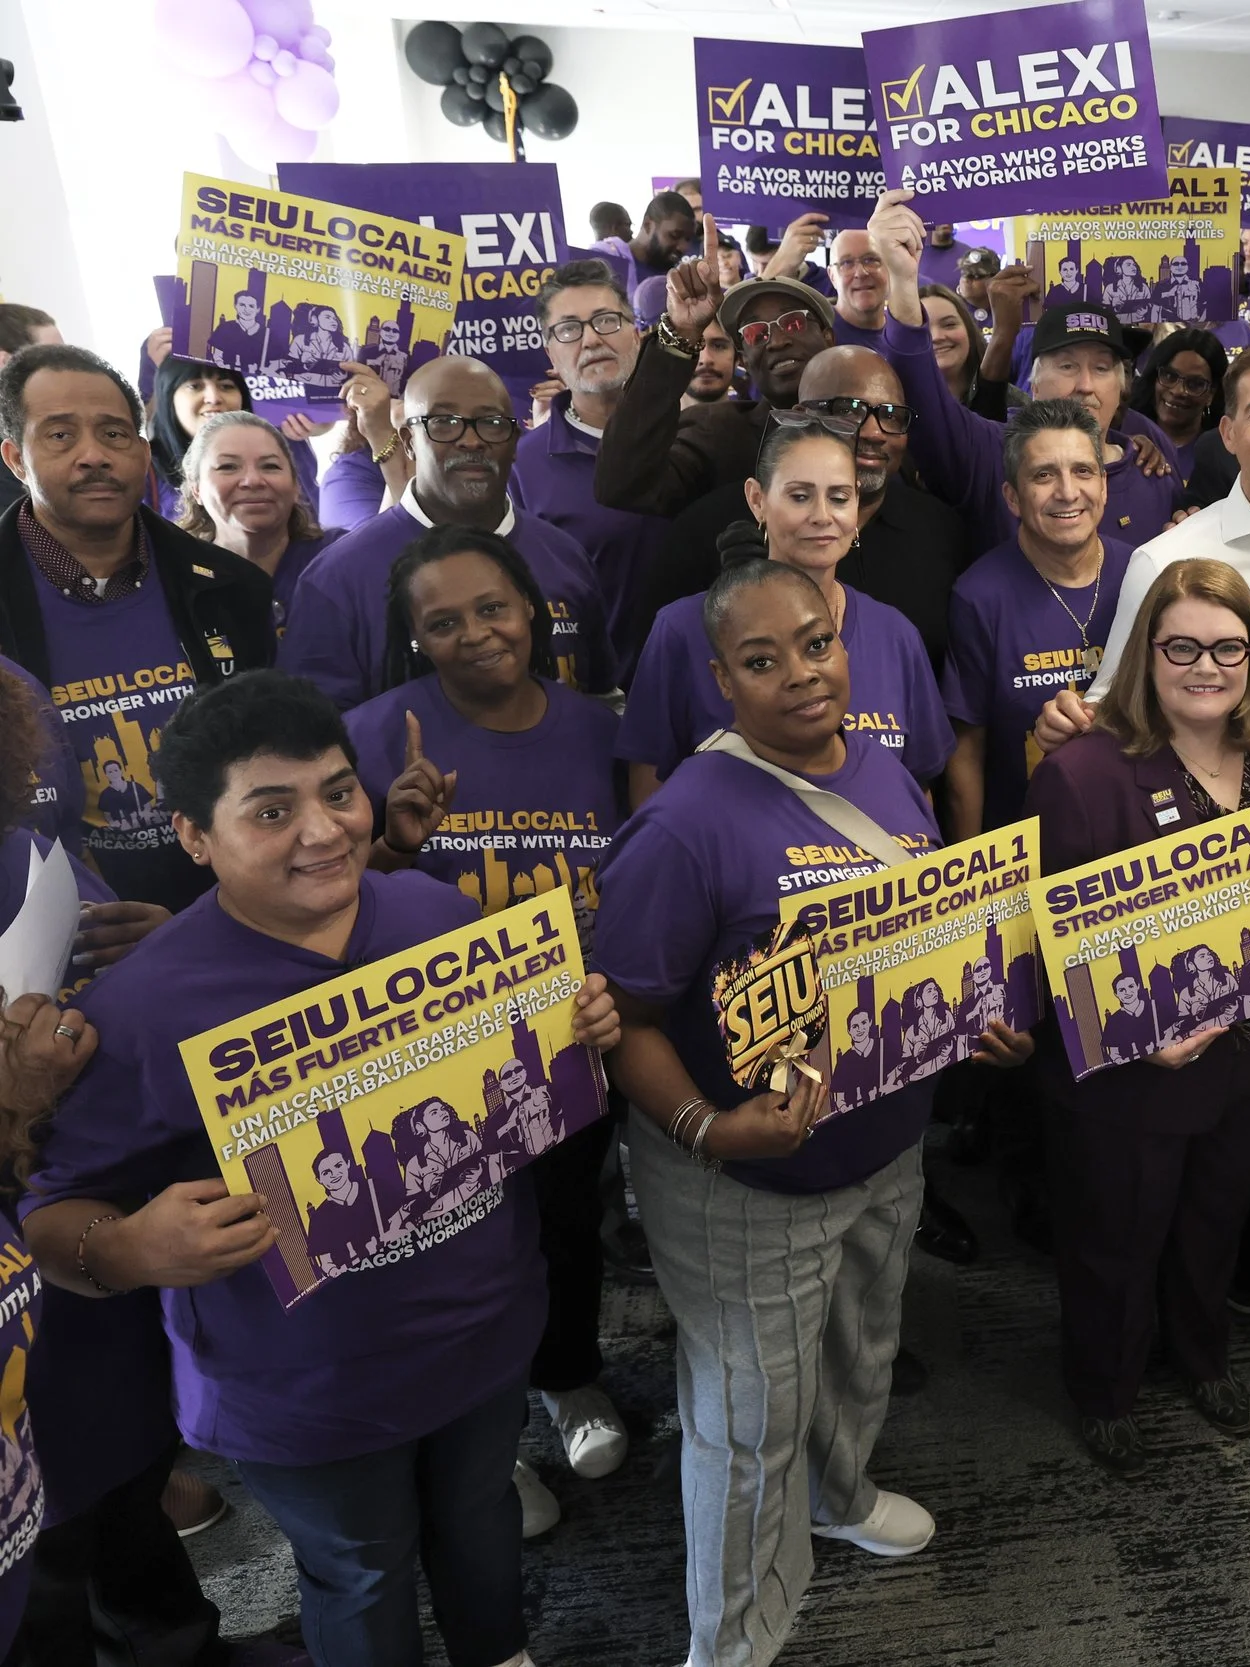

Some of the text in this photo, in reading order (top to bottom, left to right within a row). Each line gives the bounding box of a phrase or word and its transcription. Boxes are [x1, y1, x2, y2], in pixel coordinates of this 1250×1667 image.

[928, 41, 1135, 115] ALEXI
[712, 127, 776, 153] FOR
[890, 94, 1138, 149] FOR CHICAGO
[736, 166, 800, 183] MAYOR
[805, 170, 851, 184] WHO
[921, 135, 1145, 179] MAYOR WHO WORKS
[951, 151, 1147, 190] WORKING PEOPLE
[718, 179, 849, 198] FOR WORKING
[1127, 201, 1227, 215] WITH ALEXI
[197, 186, 430, 261] SEIU LOCAL
[1052, 220, 1213, 231] MAYOR WHO WORKS FOR
[1105, 229, 1224, 240] WORKING FAMILIES
[191, 212, 451, 285] MÁS FUERTE CON ALEXI
[193, 237, 287, 266] UN ALCALDE
[1066, 314, 1108, 330] SEIU
[1014, 669, 1092, 688] STRONGER
[1024, 649, 1075, 672] SEIU
[51, 676, 116, 706] SEIU
[436, 810, 598, 833] SEIU LOCAL 1
[420, 834, 566, 853] STRONGER WITH
[786, 845, 847, 866] SEIU
[797, 844, 1006, 936] SEIU LOCAL
[853, 865, 1029, 947] FUERTE CON ALEXI
[1046, 859, 1144, 916] SEIU
[1052, 881, 1179, 938] STRONGER
[1181, 858, 1241, 892] WITH
[1094, 915, 1156, 946] MAYOR
[1159, 899, 1201, 922] WHO
[1163, 900, 1241, 934] WORKING
[828, 898, 1008, 977] ALCALDE QUE TRABAJA PARA
[864, 920, 983, 976] TRABAJADORAS DE
[208, 927, 528, 1082] SEIU LOCAL
[720, 969, 755, 1008] THIS UNION
[727, 953, 817, 1056] SEIU
[295, 943, 566, 1080] FUERTE CON ALEXI
[790, 1002, 824, 1032] OUR UNION
[222, 979, 582, 1161] FAMILIAS TRABAJADORAS DE CHICAGO
[230, 970, 572, 1138] UN ALCALDE QUE TRABAJA PARA LAS
[415, 1211, 453, 1238] WHO
[416, 1210, 486, 1252] WORKING
